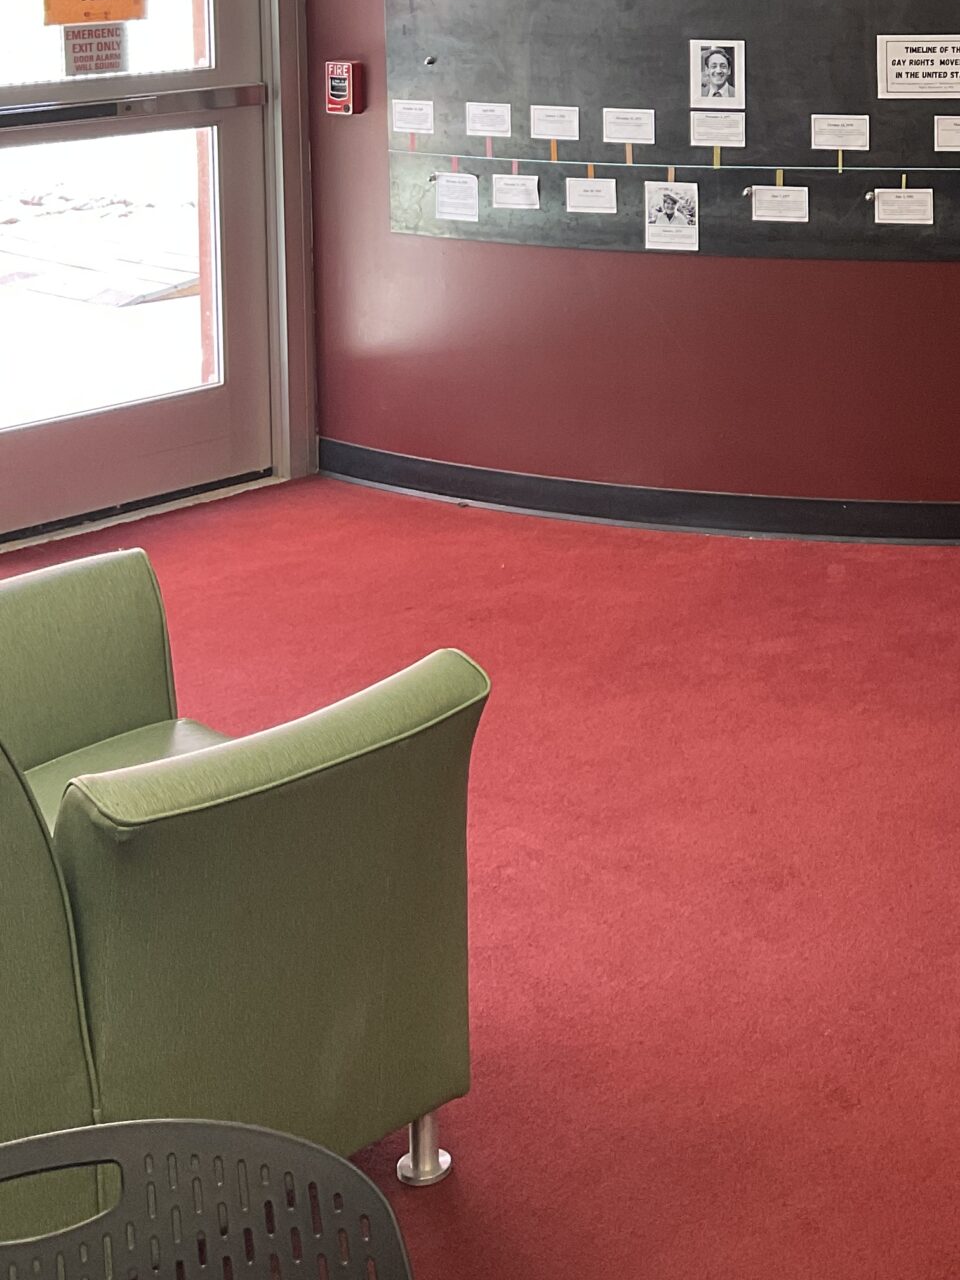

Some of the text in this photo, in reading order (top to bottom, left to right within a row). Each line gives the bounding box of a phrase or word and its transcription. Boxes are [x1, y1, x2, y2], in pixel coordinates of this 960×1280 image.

[66, 28, 121, 40] EMERGENC
[72, 41, 121, 53] EXIT ONLY
[74, 55, 93, 63] DOOR
[328, 64, 349, 76] FIRE
